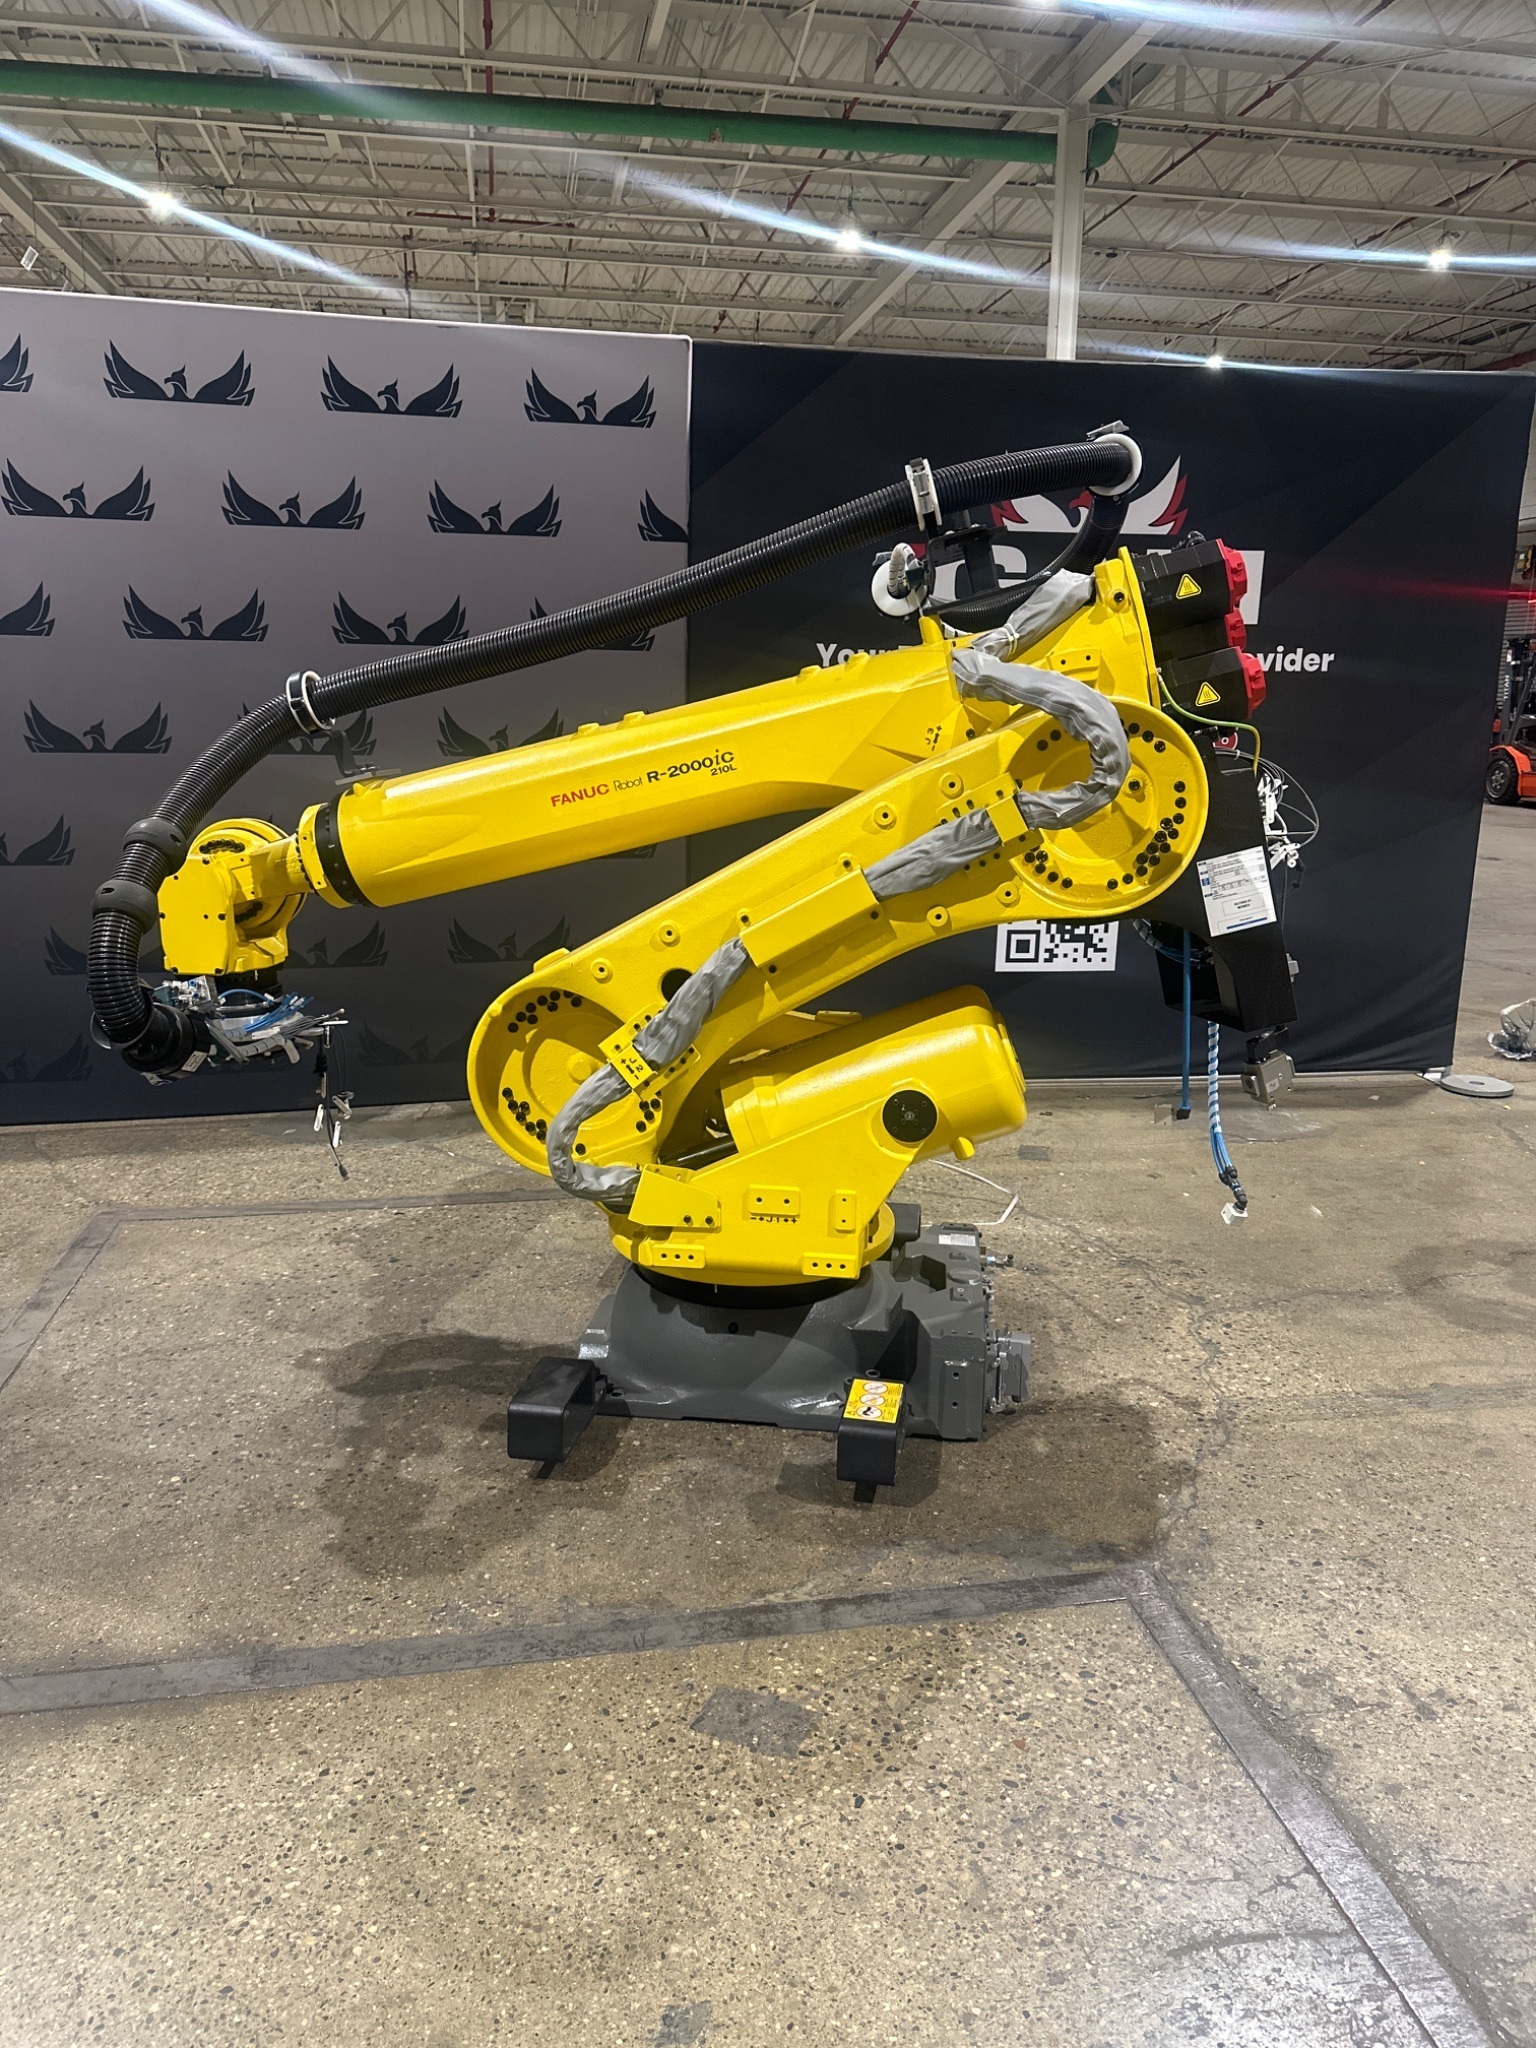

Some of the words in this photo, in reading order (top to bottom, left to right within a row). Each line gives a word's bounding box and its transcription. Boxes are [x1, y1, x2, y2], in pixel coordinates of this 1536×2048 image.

[816, 643, 892, 667] Yo
[1245, 645, 1335, 673] vider
[550, 783, 610, 808] FANUC
[613, 776, 643, 792] Robot
[646, 749, 735, 783] R-2000iC
[710, 764, 738, 777] 210L
